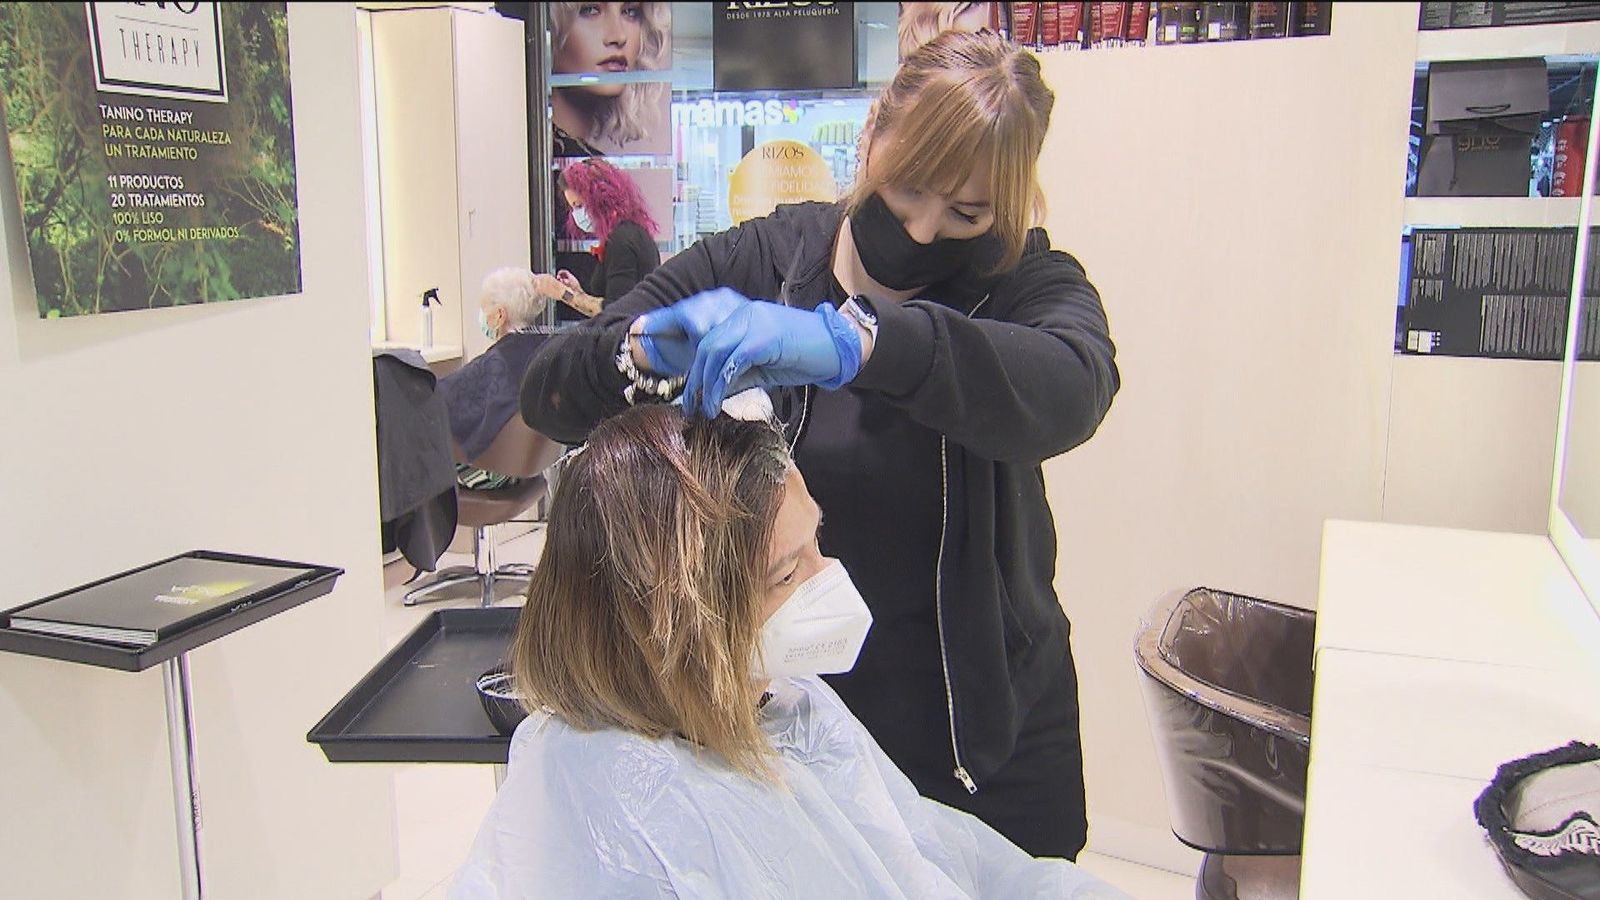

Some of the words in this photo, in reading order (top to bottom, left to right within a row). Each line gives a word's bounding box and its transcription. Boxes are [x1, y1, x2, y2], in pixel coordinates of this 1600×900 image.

[774, 10, 791, 18] ALTA
[119, 28, 200, 67] THERAPY
[99, 104, 144, 121] TANINO
[146, 108, 193, 125] THERAPY
[102, 124, 132, 140] PARA
[135, 126, 166, 141] CADA
[167, 129, 232, 145] NATURALEZA
[104, 143, 121, 157] UN
[124, 144, 198, 160] TRATAMIENTO
[762, 146, 804, 160] RIZOS
[107, 175, 117, 188] 11
[120, 174, 184, 189] PRODUCTOS
[111, 193, 126, 207] 20
[127, 193, 205, 207] TRATAMIENTOS
[113, 212, 139, 225] 100%
[141, 211, 164, 225] LISO
[115, 230, 130, 242] 0%
[133, 228, 176, 241] FORMOL
[177, 227, 187, 240] NI
[190, 226, 239, 240] DERIVADOS
